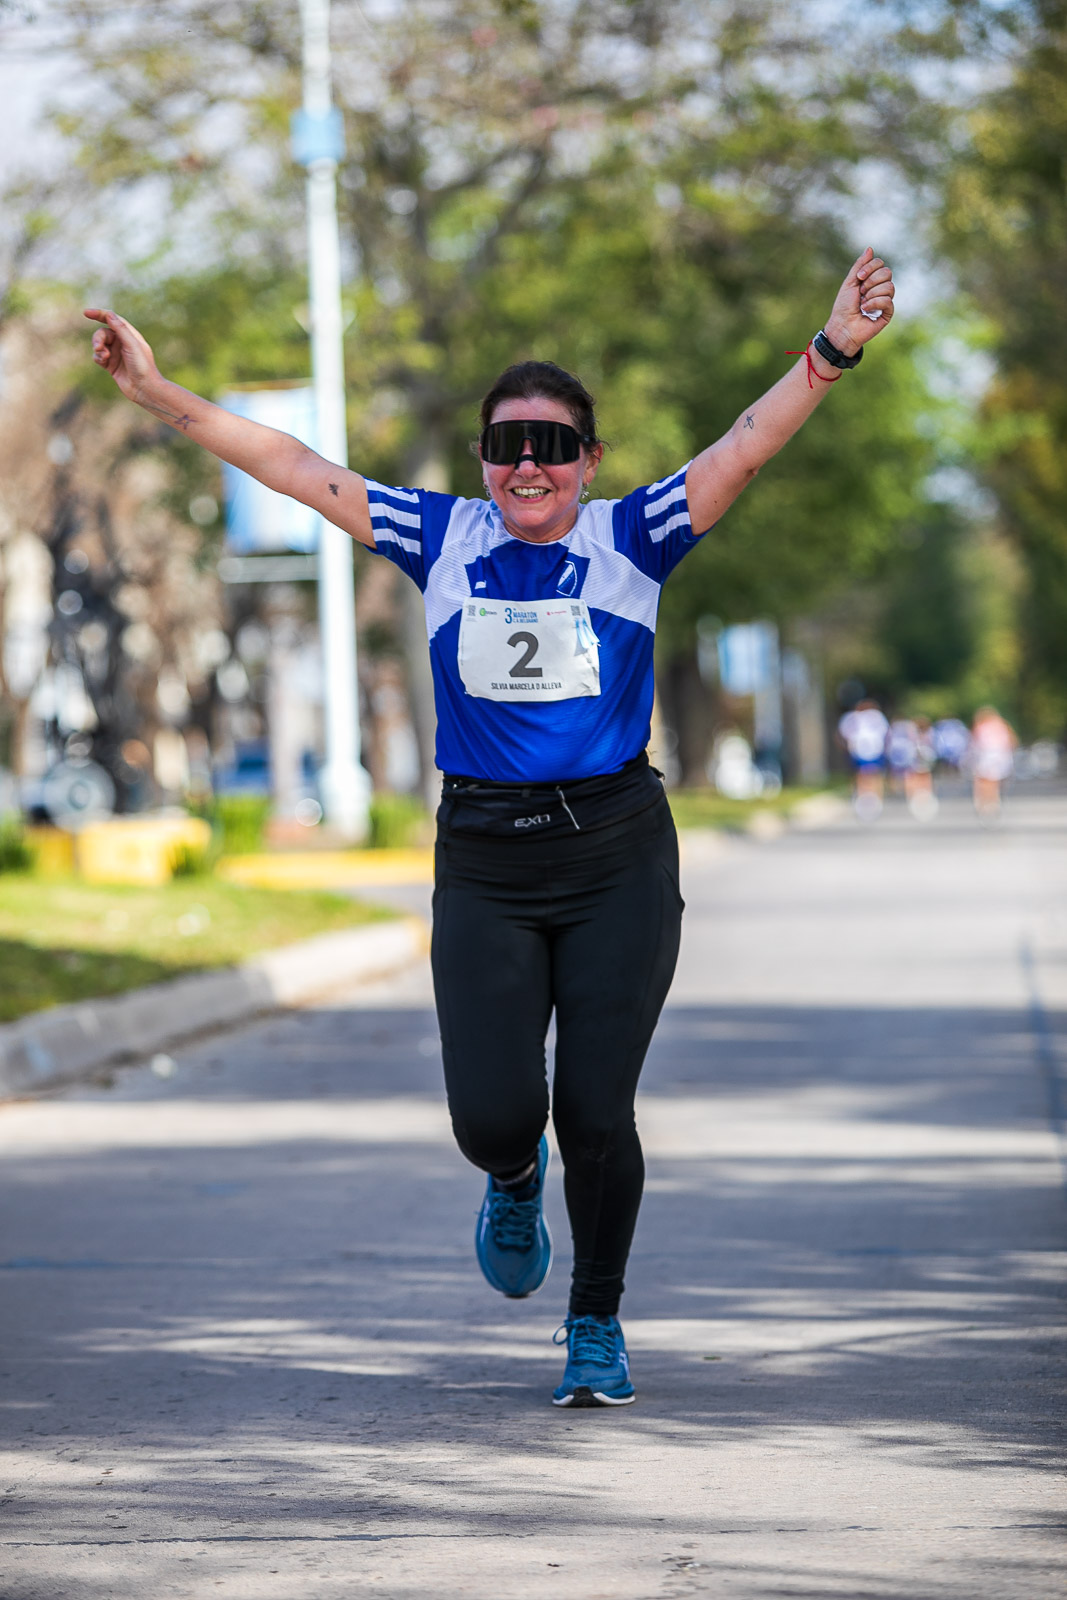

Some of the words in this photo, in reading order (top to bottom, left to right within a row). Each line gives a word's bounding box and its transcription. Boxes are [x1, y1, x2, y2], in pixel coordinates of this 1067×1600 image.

[506, 631, 543, 678] 2
[491, 682, 508, 690] SILVIA
[508, 682, 535, 690] MARCELA
[541, 682, 562, 690] ALLEVA
